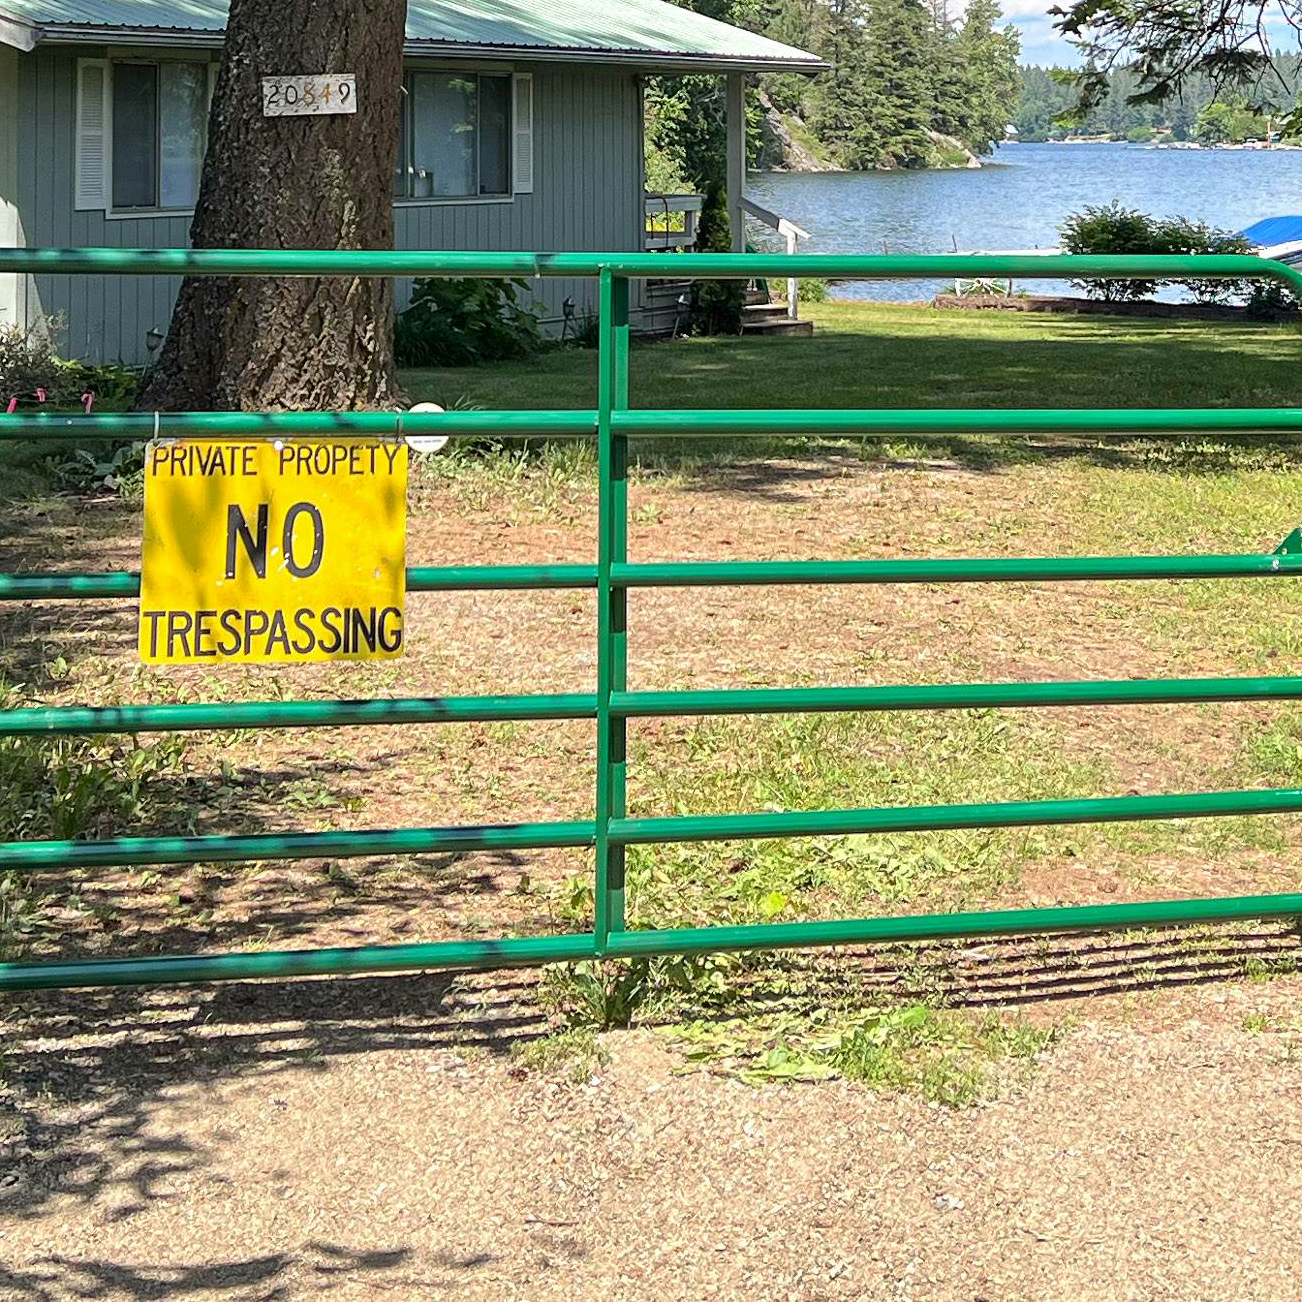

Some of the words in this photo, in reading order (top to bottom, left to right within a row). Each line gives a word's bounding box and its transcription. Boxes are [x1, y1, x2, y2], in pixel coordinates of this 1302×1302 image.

[267, 80, 351, 107] 20849
[151, 445, 258, 477] PRIVATE
[278, 445, 400, 476] PROPETY
[224, 501, 325, 580] NO
[142, 606, 403, 659] TRESPASSING
